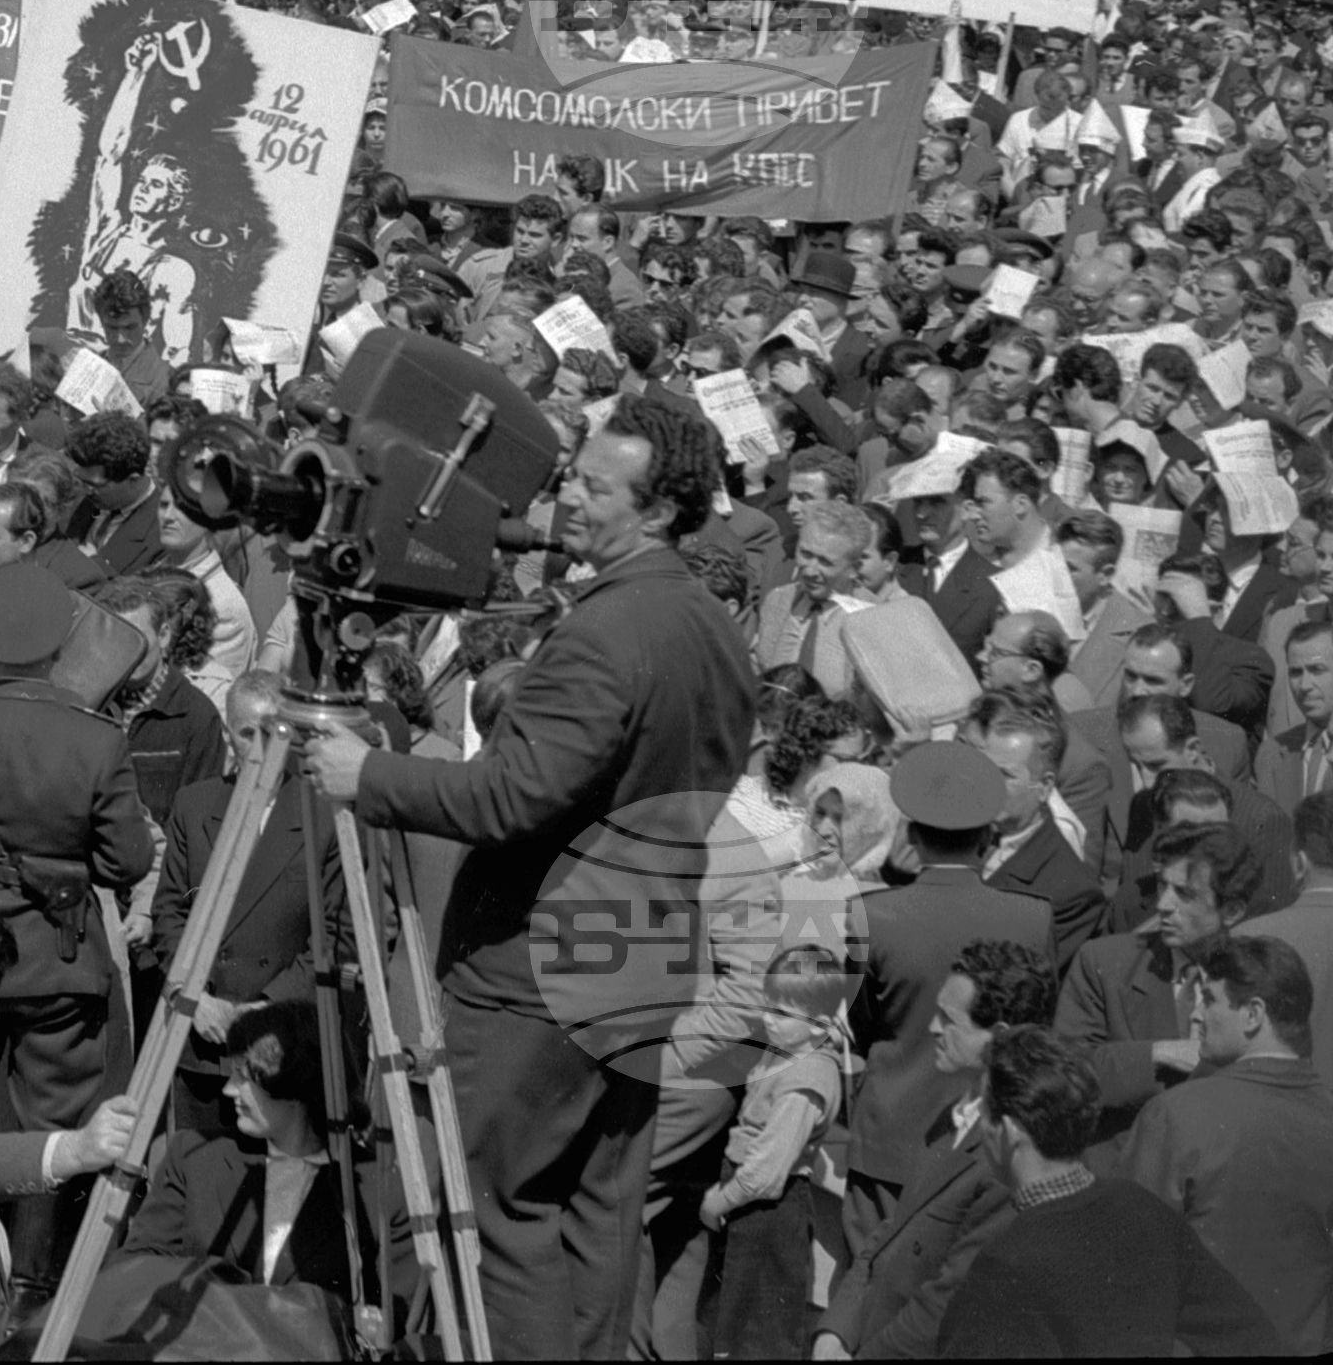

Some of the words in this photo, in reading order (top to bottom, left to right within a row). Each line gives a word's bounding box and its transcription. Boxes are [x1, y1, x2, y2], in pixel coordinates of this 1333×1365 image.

[268, 83, 305, 114] 12
[439, 74, 711, 130] КОМСОМОЛСКИ
[737, 80, 892, 128] ПРИВЕТ
[249, 109, 328, 141] април
[254, 131, 323, 176] 1961
[513, 149, 559, 187] НА
[662, 158, 709, 193] НА
